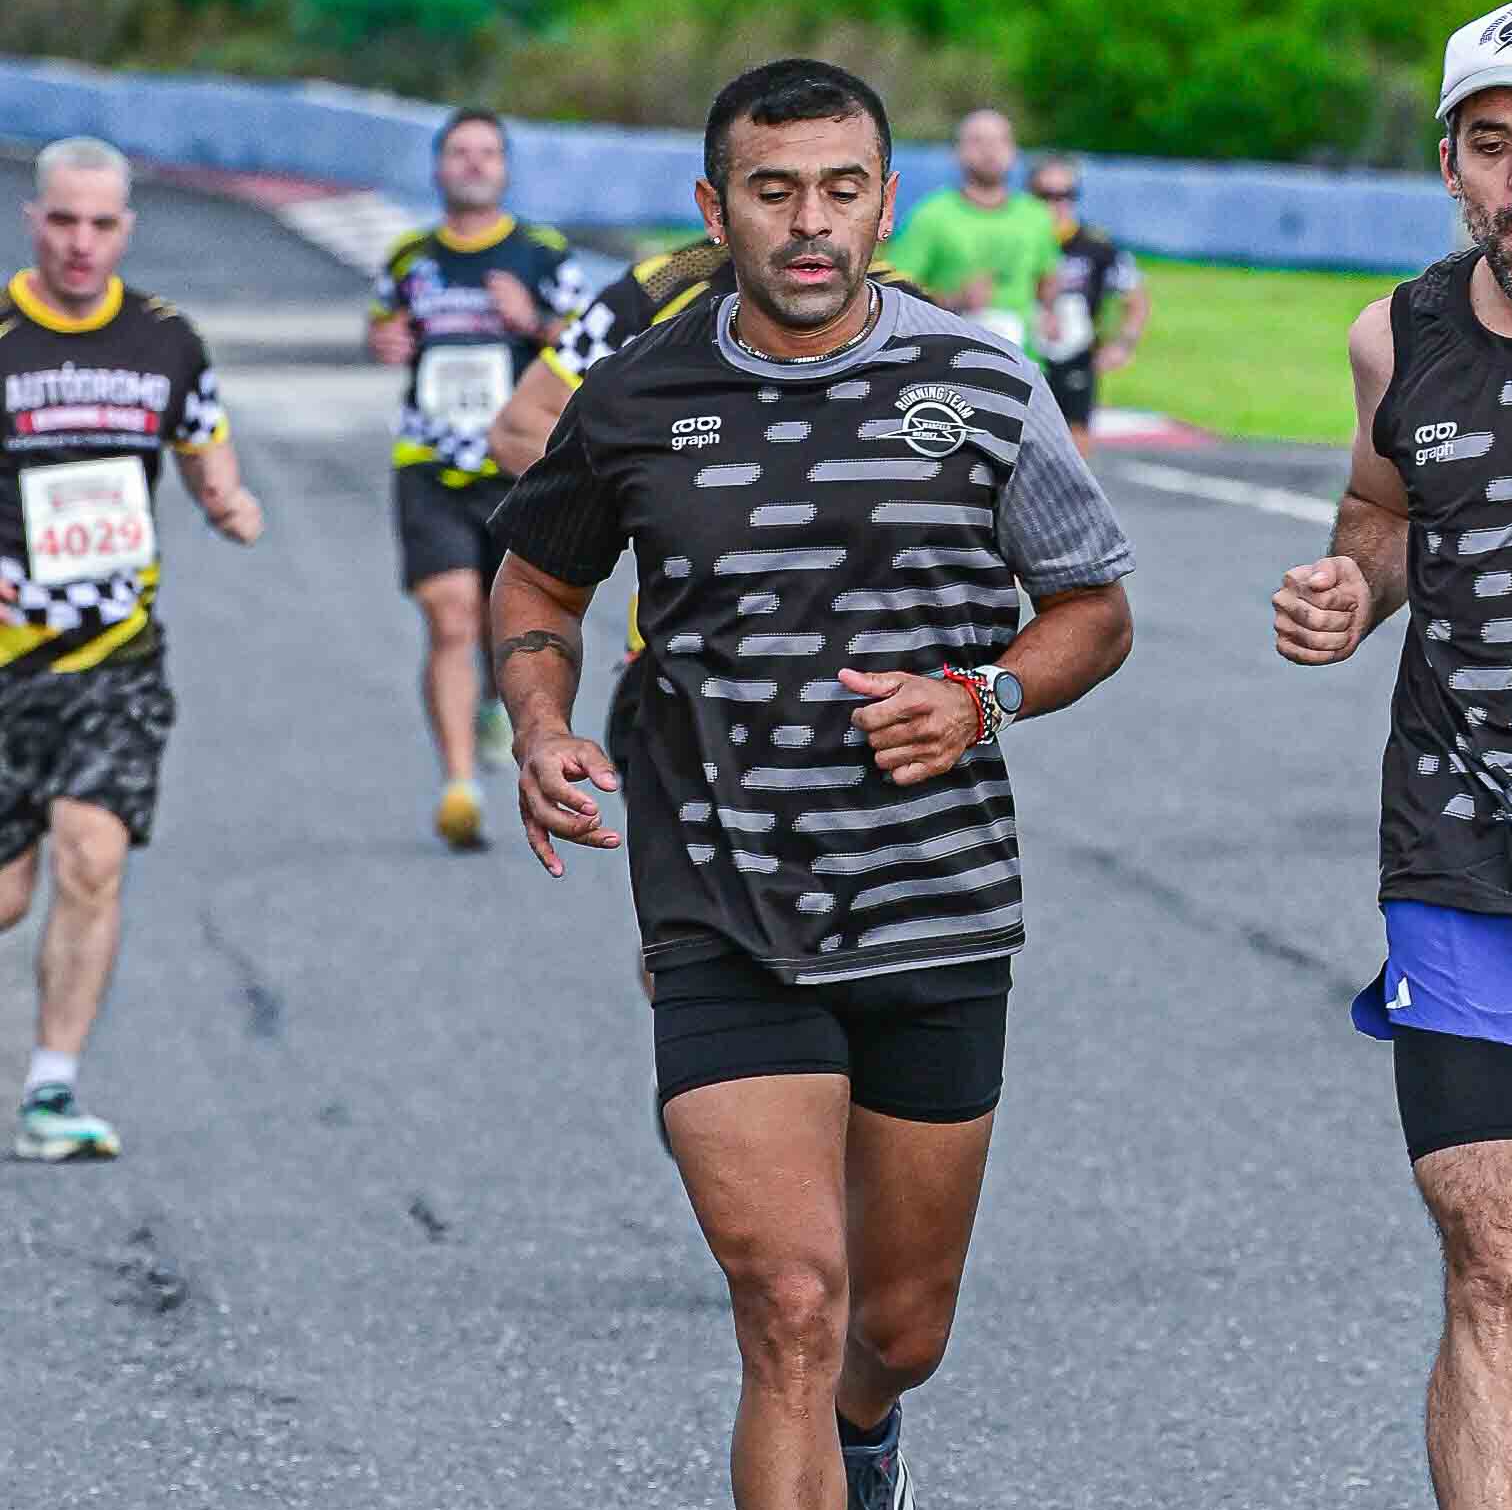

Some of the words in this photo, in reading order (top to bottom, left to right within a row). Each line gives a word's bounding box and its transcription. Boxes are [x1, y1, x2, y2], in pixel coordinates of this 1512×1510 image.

[895, 387, 945, 411] RUNNING
[945, 390, 975, 419] TEAM
[671, 431, 720, 451] graph
[1415, 441, 1454, 465] graph
[34, 517, 143, 556] 4029
